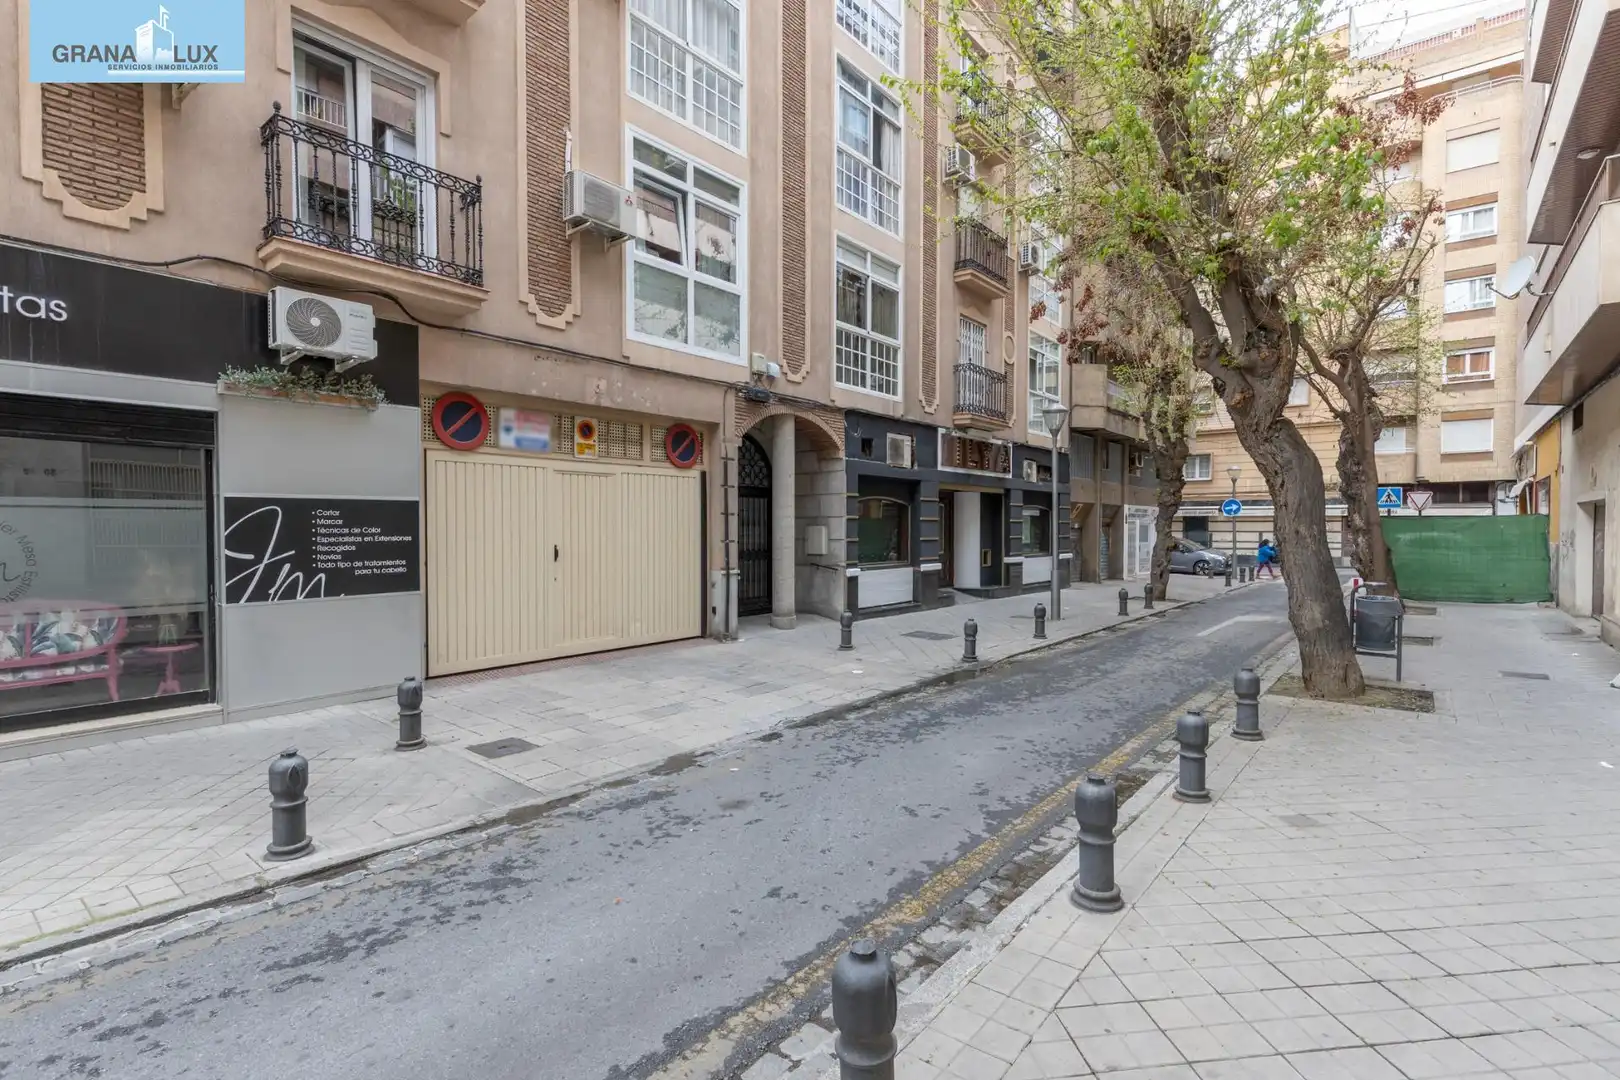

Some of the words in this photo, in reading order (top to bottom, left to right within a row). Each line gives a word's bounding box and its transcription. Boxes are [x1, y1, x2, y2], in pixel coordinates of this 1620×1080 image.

[0, 285, 68, 322] tas
[316, 536, 362, 544] Especialistas
[316, 544, 356, 552] Recogidos
